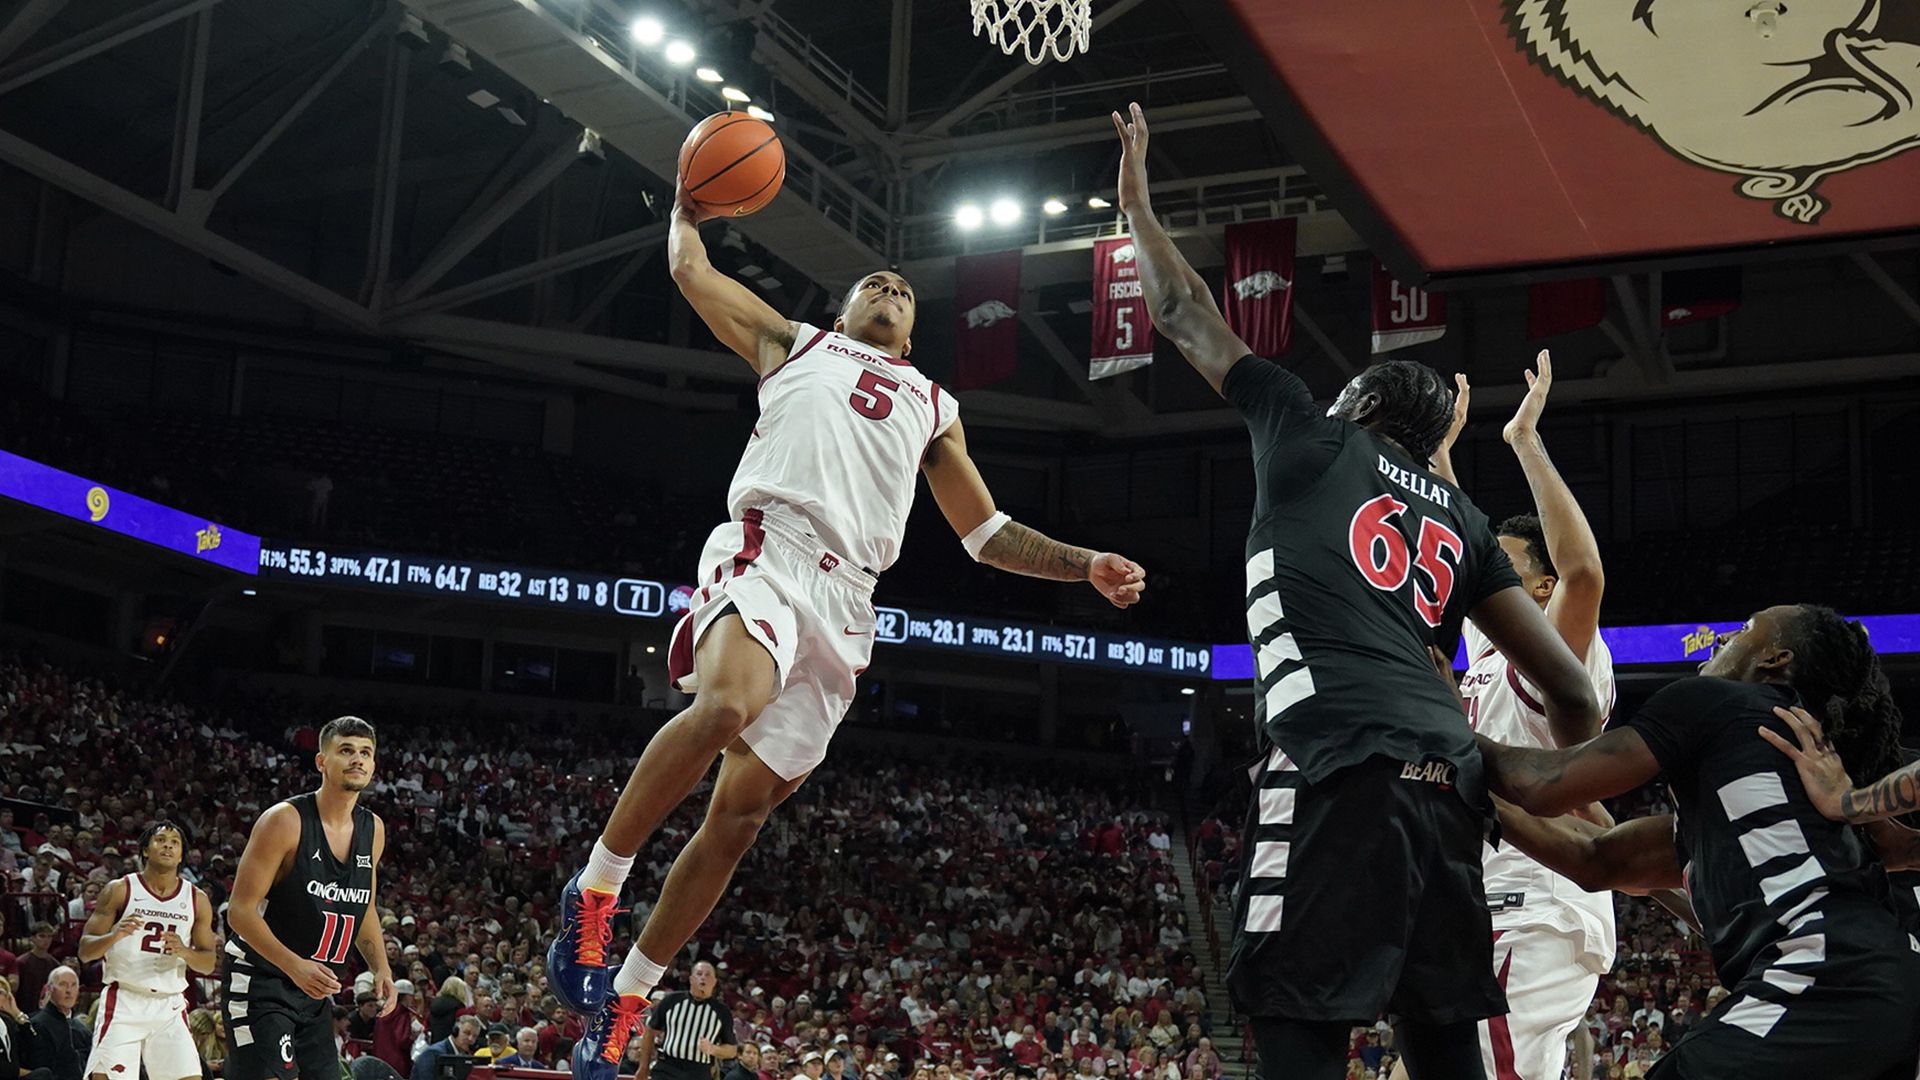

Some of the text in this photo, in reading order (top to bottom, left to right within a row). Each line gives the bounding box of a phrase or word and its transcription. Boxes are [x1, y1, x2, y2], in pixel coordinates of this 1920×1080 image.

[1109, 281, 1143, 299] FISCUS
[1116, 307, 1133, 350] 5
[849, 368, 900, 421] 5
[1378, 454, 1451, 509] DZELLAT
[289, 548, 327, 577] 55.3
[330, 557, 361, 576] 3PT%
[364, 557, 400, 584] 47.1
[407, 565, 431, 584] FT%
[435, 564, 471, 591] 64.7
[478, 573, 498, 591] REB
[499, 571, 522, 597] 32
[528, 578, 547, 596] AST
[548, 577, 570, 602] 13
[577, 584, 590, 601] TO
[595, 582, 608, 606] 8
[630, 585, 650, 610] 71
[1349, 493, 1463, 628] 65
[876, 613, 1210, 672] 42 FG% 28.1 3PT% 23.1 FT% 57.1 REB 30 AST 11 TO 9
[1682, 627, 1715, 657] Takis
[135, 908, 188, 921] RAZORBACKS
[307, 880, 370, 904] CINCINNATI
[311, 911, 355, 964] 11
